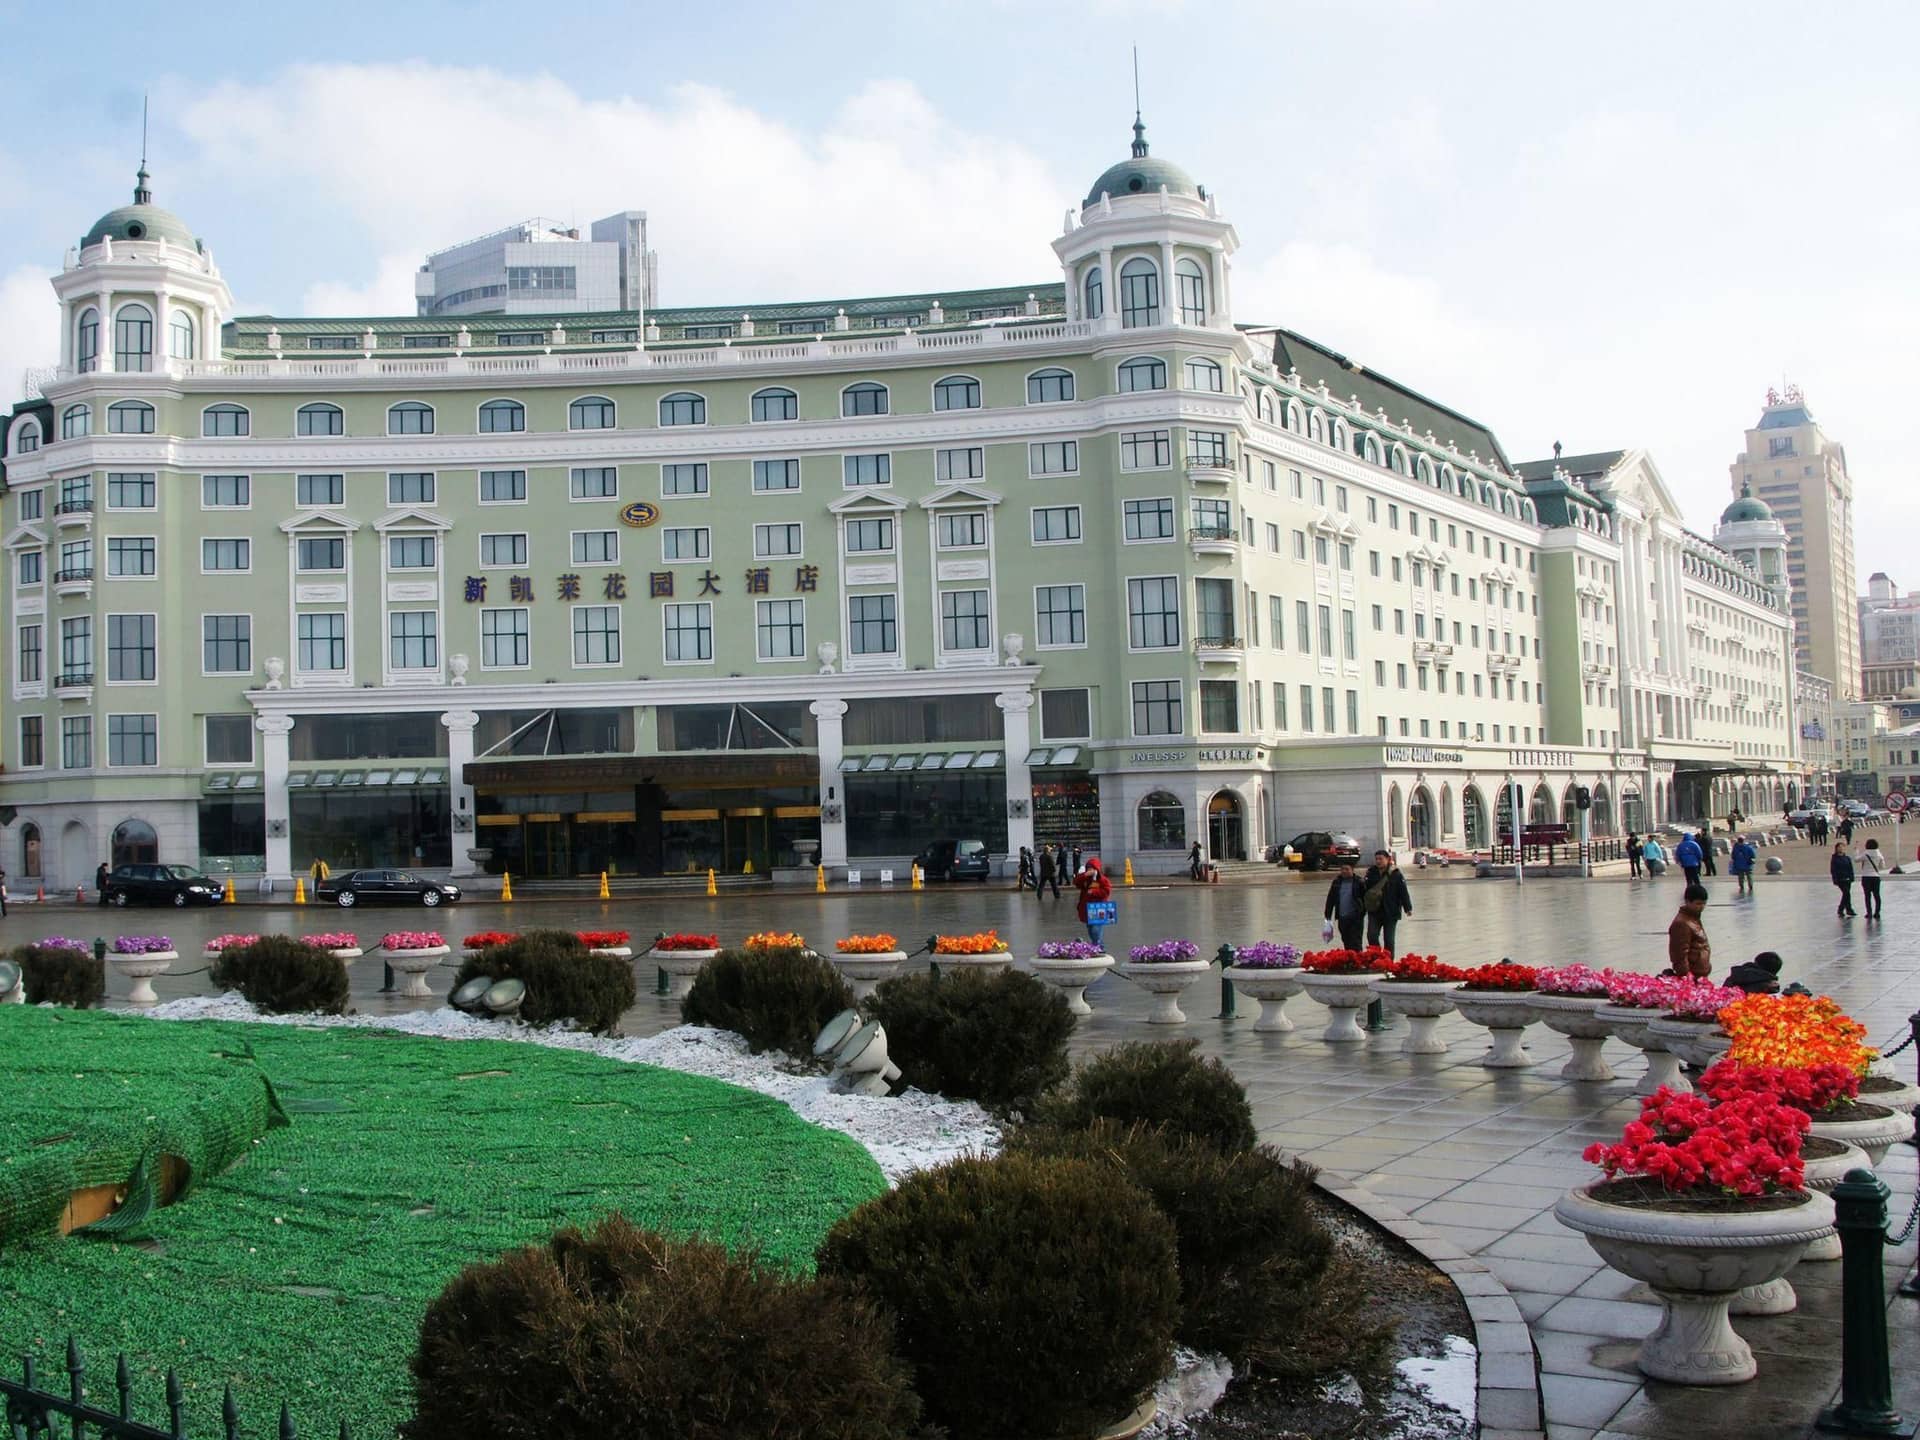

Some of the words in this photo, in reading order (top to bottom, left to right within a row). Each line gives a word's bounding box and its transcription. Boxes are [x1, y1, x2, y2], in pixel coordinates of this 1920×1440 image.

[464, 564, 819, 603] 新凯莱花园大酒店
